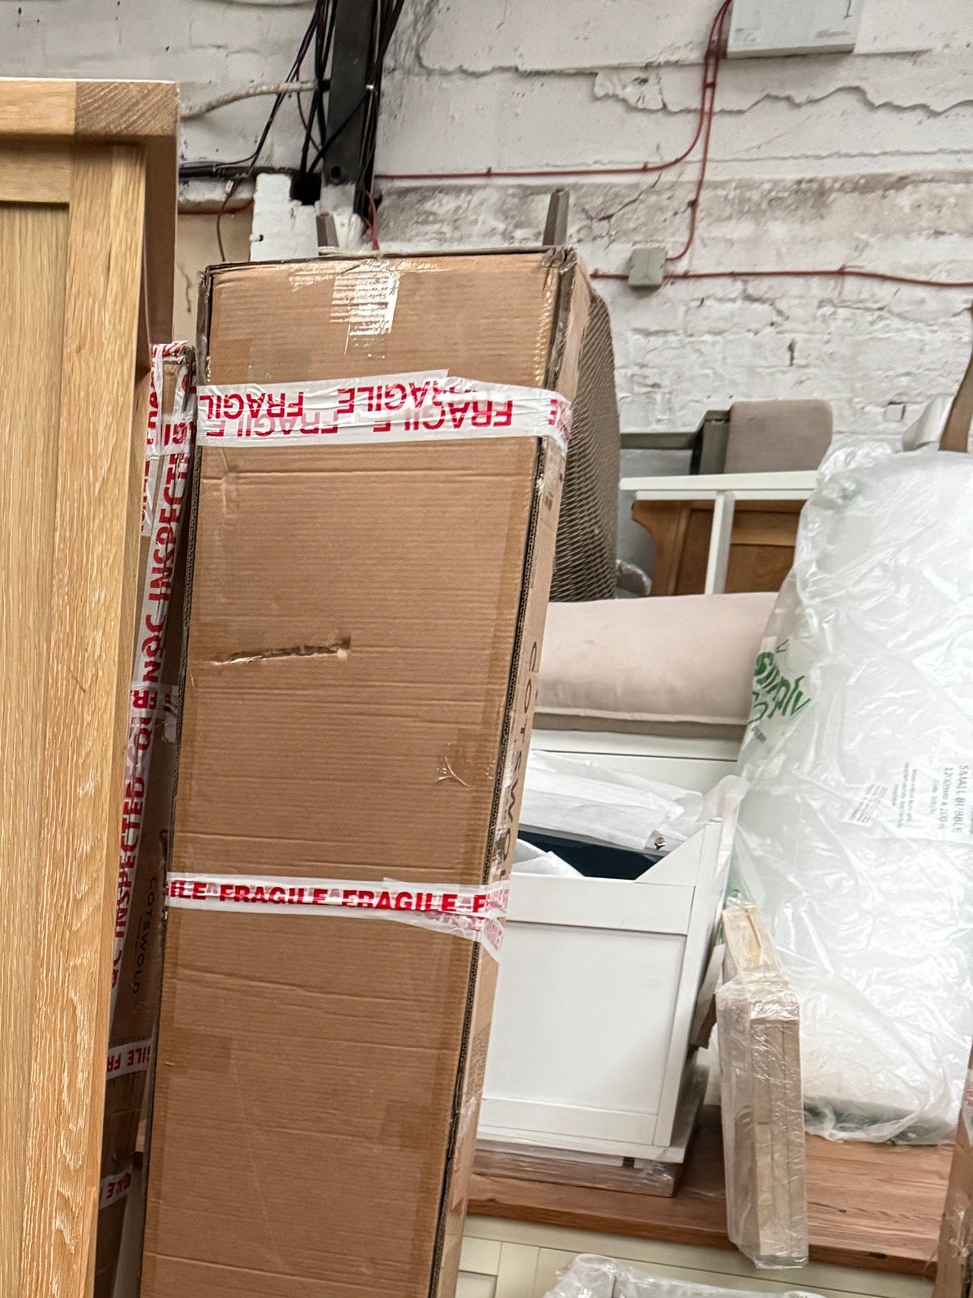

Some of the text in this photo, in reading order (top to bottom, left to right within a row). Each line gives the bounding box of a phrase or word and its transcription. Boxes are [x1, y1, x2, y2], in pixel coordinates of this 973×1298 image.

[499, 641, 538, 880] COTSWOL
[132, 876, 156, 994] COTSWOLD
[219, 885, 327, 905] FRAGILE
